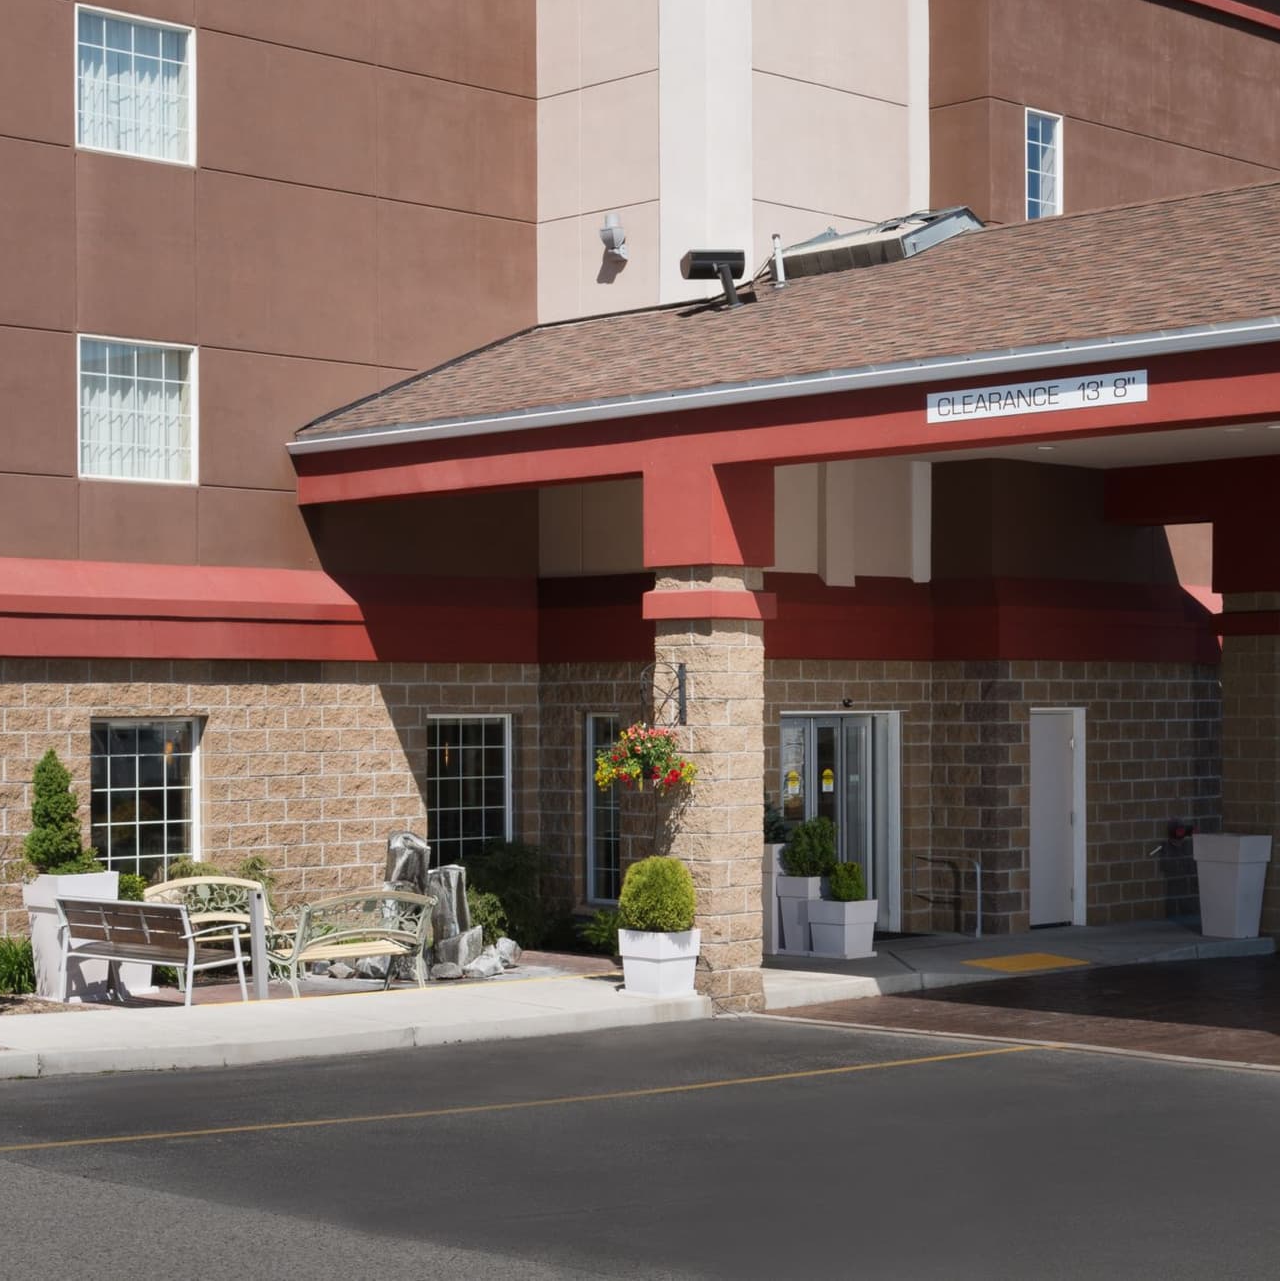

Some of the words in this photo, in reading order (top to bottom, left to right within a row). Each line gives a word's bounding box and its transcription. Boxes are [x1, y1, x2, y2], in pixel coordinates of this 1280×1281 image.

[937, 385, 1059, 416] CLEARANCE
[1077, 380, 1104, 402] 13'
[1113, 376, 1136, 398] 8"
